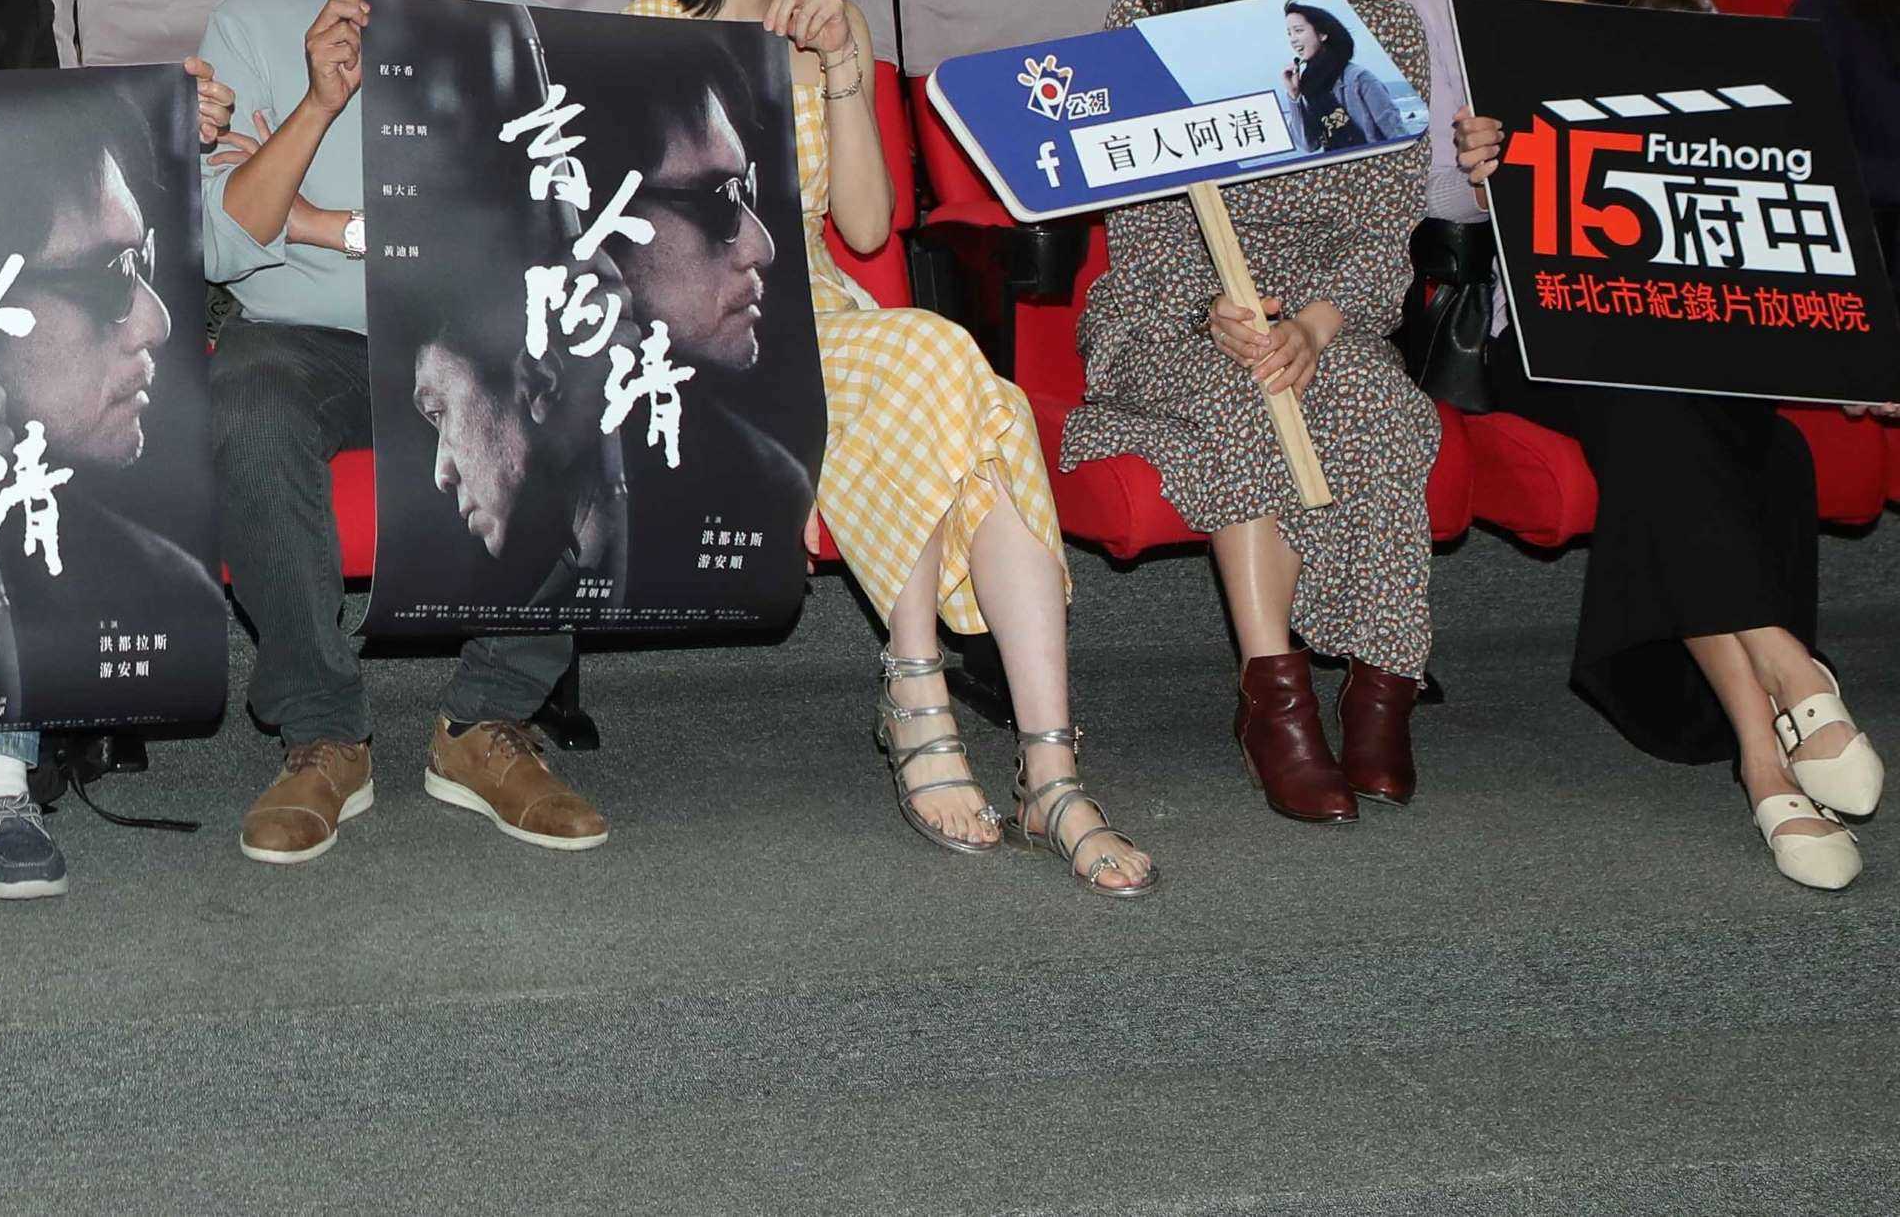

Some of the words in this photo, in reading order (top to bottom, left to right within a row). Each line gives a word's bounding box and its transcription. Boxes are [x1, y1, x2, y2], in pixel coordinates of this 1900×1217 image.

[1068, 88, 1112, 120] 公視
[1100, 110, 1267, 172] 盲人阿清
[1647, 133, 1812, 181] Fuzhong
[1503, 114, 1663, 259] 15
[1534, 270, 1871, 332] 新北市紀錄片放映院
[701, 529, 763, 547] 洪都拉斯
[100, 634, 167, 652] 洪都拉斯
[100, 661, 149, 678] 游安順
